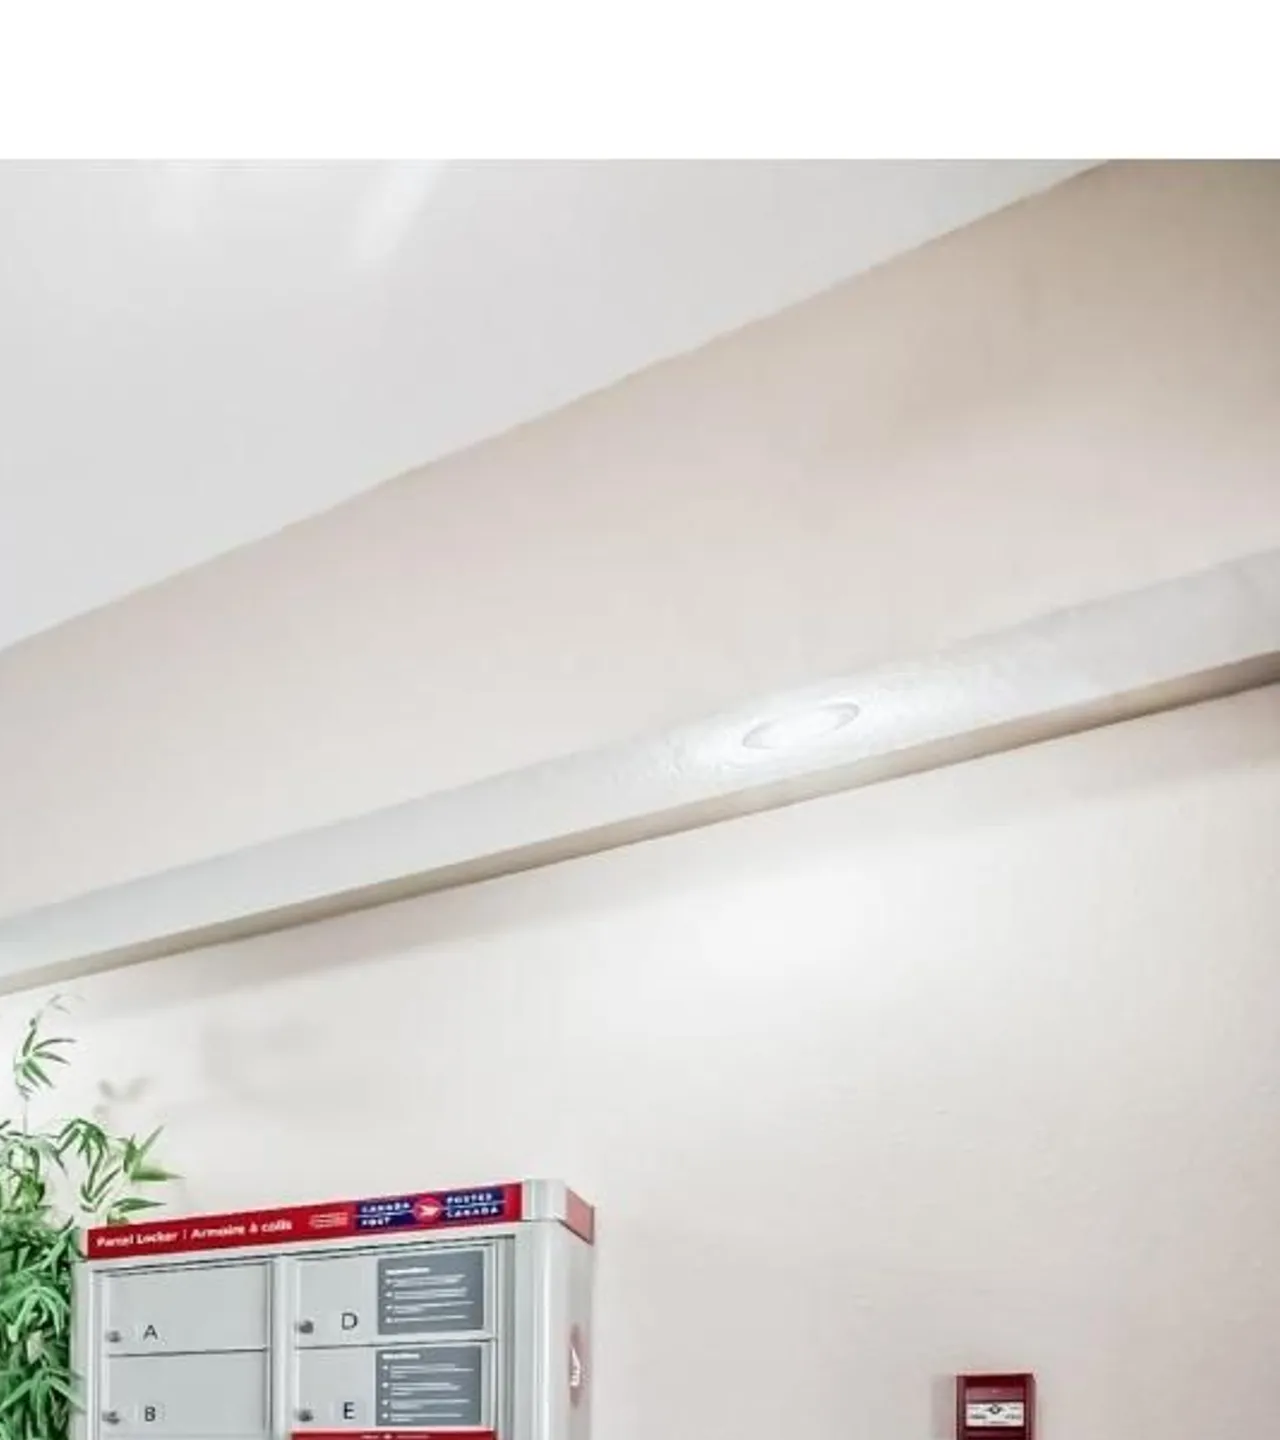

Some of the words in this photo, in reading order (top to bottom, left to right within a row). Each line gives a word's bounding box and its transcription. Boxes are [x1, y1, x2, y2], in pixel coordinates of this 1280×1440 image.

[447, 1206, 499, 1218] CANADA
[96, 1234, 133, 1248] Parcel
[136, 1230, 179, 1246] Locker
[191, 1224, 246, 1239] Armoire
[261, 1219, 293, 1233] colis
[341, 1312, 358, 1330] D
[143, 1324, 159, 1340] A
[144, 1406, 156, 1422] B
[343, 1402, 355, 1420] E
